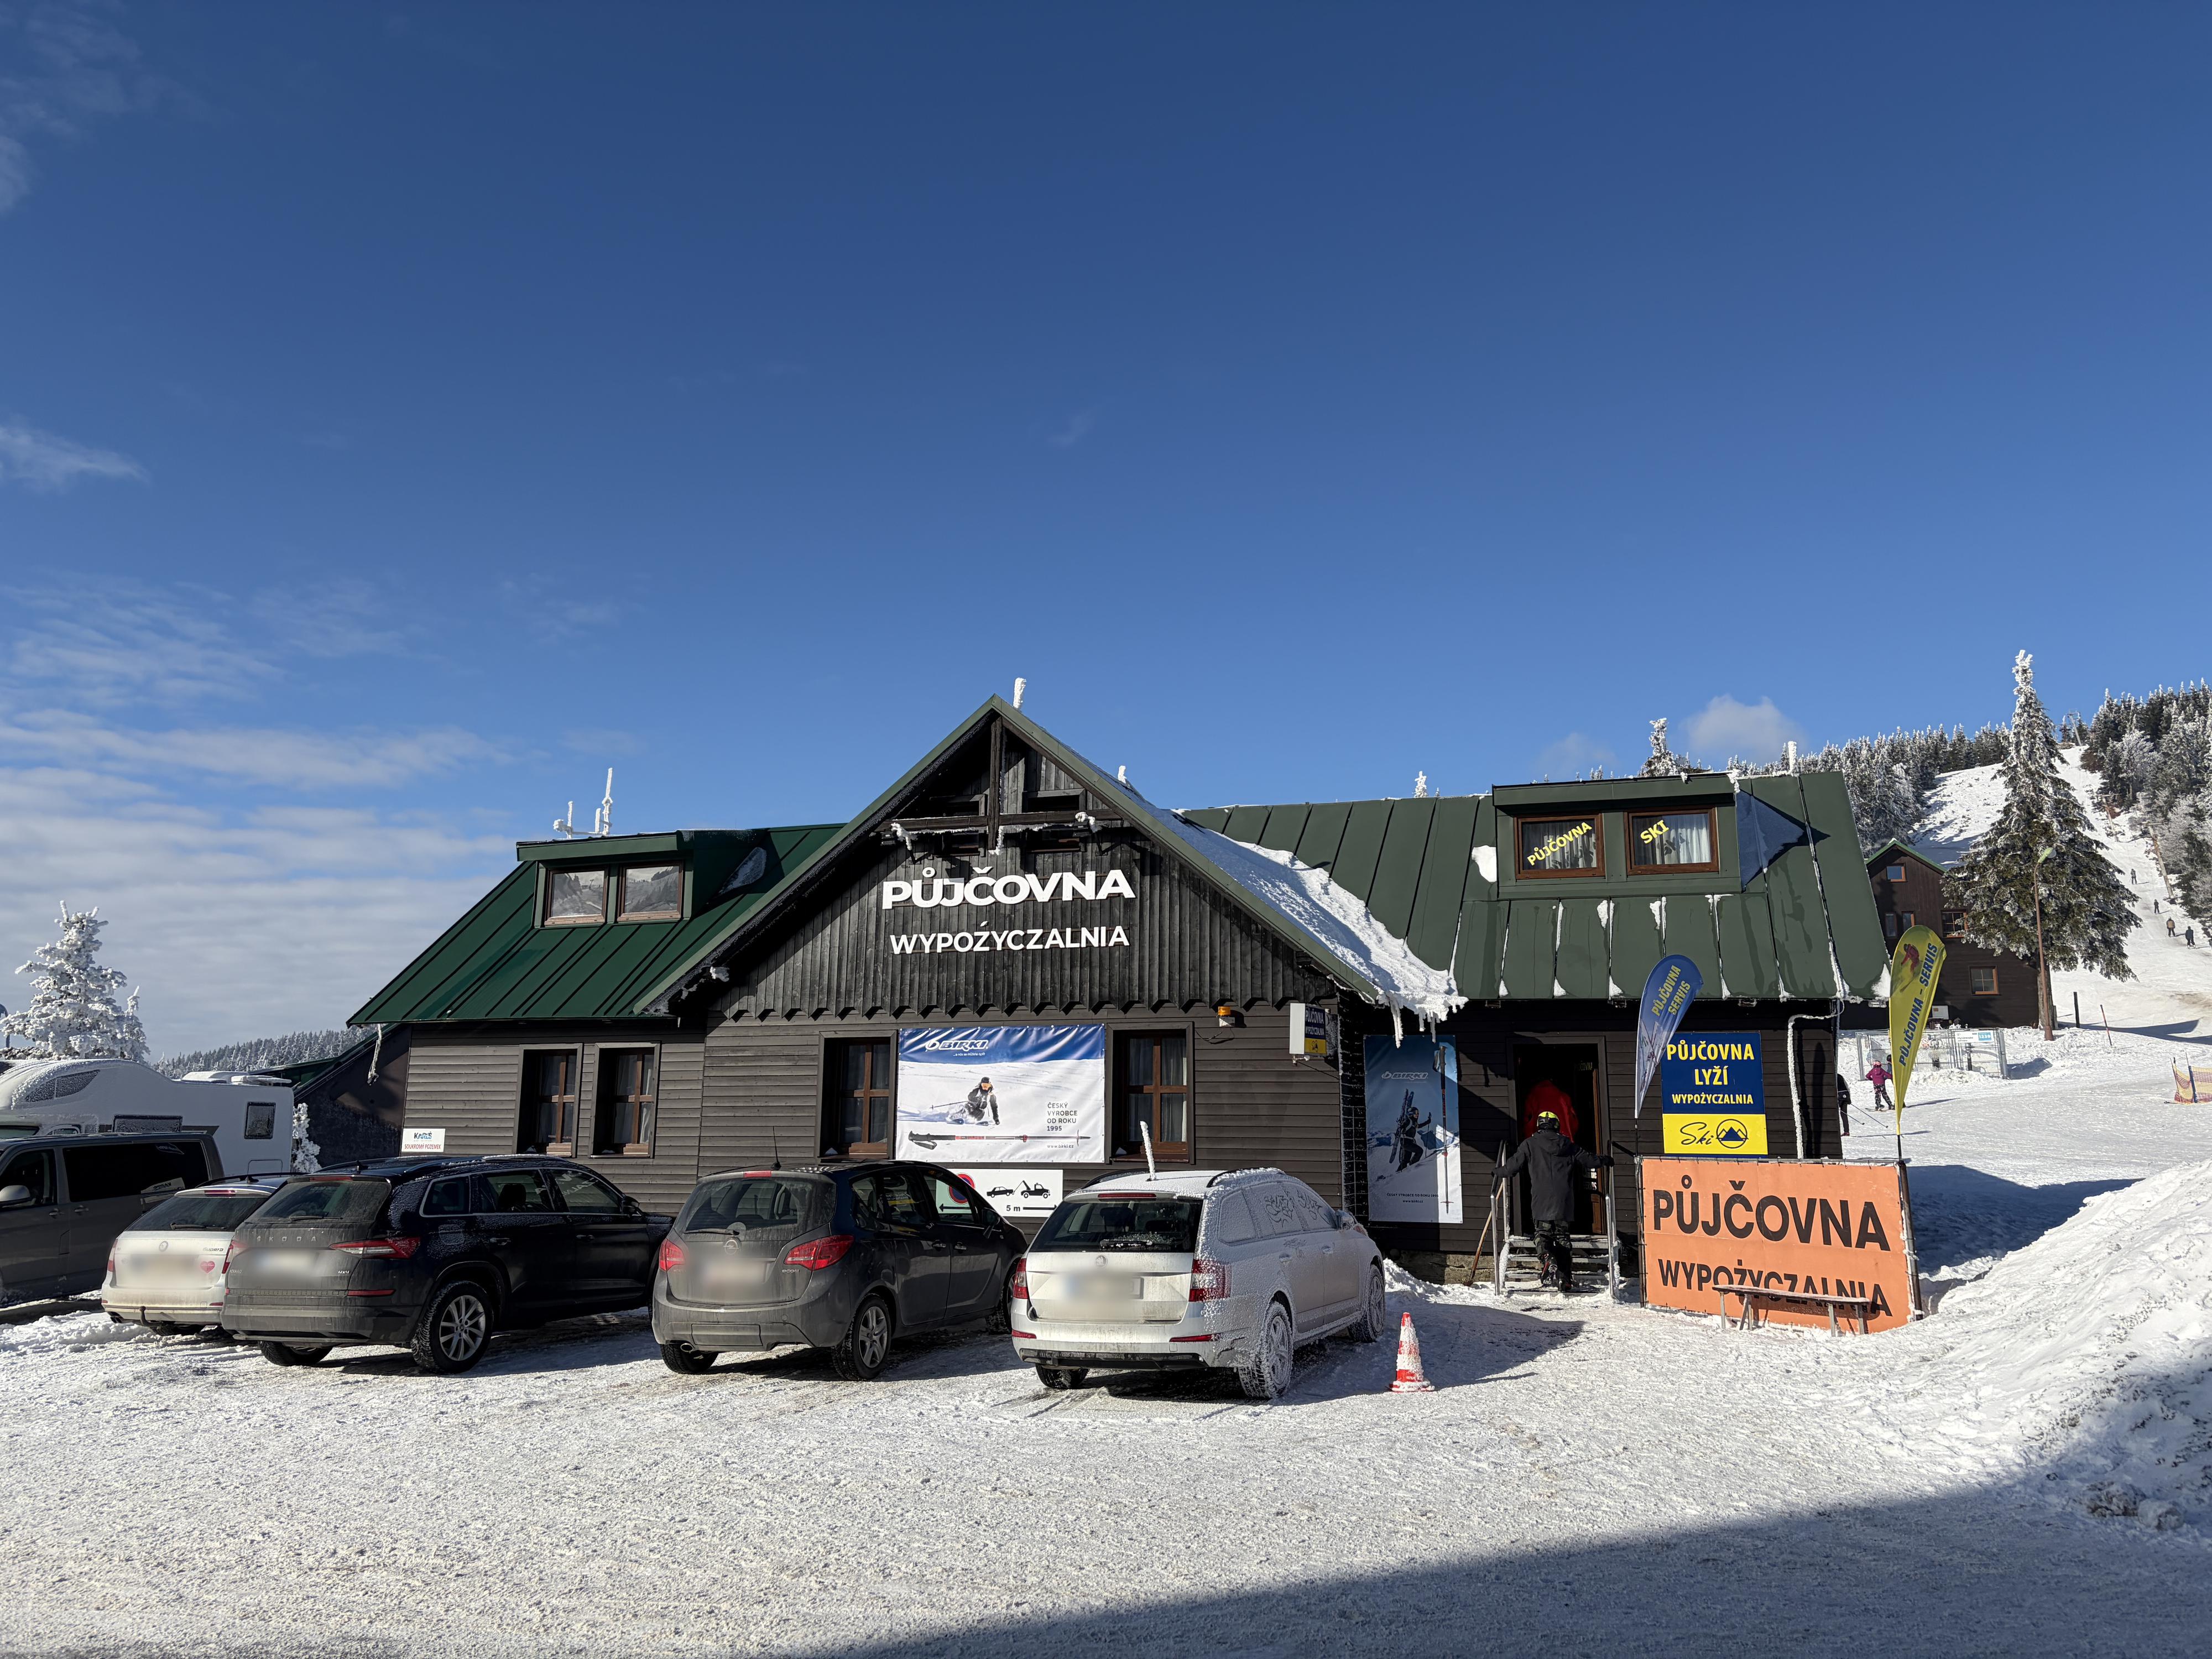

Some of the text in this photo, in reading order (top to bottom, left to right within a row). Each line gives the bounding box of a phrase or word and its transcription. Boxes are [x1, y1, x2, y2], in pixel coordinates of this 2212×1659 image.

[1527, 822, 1593, 866] PŮJČOVNA
[1640, 820, 1670, 844] SKI
[882, 866, 1136, 910] PŮJČOVNA
[1651, 965, 1681, 1016] PŮJČOVNA
[1668, 980, 1691, 1015] SERVIS
[1899, 997, 1924, 1067] PŮJČOVNA
[1919, 942, 1938, 987] SERVIS
[938, 1040, 989, 1051] BIRKI
[1666, 1039, 1755, 1060] PŮJČOVNA
[1694, 1065, 1729, 1085] LYŽÍ
[1672, 1092, 1754, 1104] WYPOŻYCZALNIA
[1680, 1121, 1714, 1145] Ski
[1653, 1174, 1891, 1251] PŮJČOVNA
